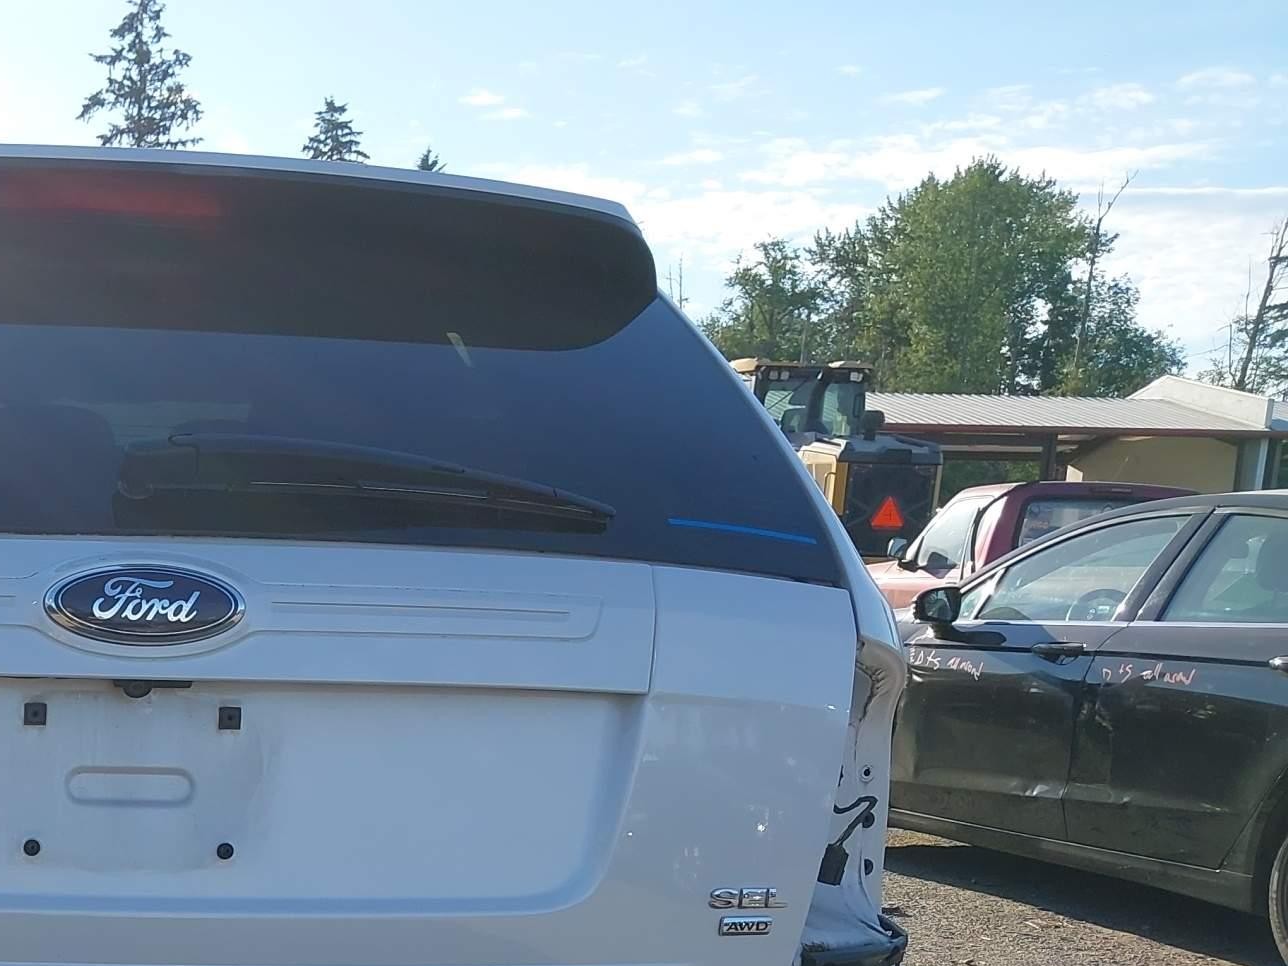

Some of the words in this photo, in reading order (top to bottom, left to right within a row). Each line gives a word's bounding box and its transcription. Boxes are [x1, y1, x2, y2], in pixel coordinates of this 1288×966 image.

[92, 576, 200, 622] Ford
[709, 887, 788, 909] SEL
[725, 920, 769, 932] AWD
